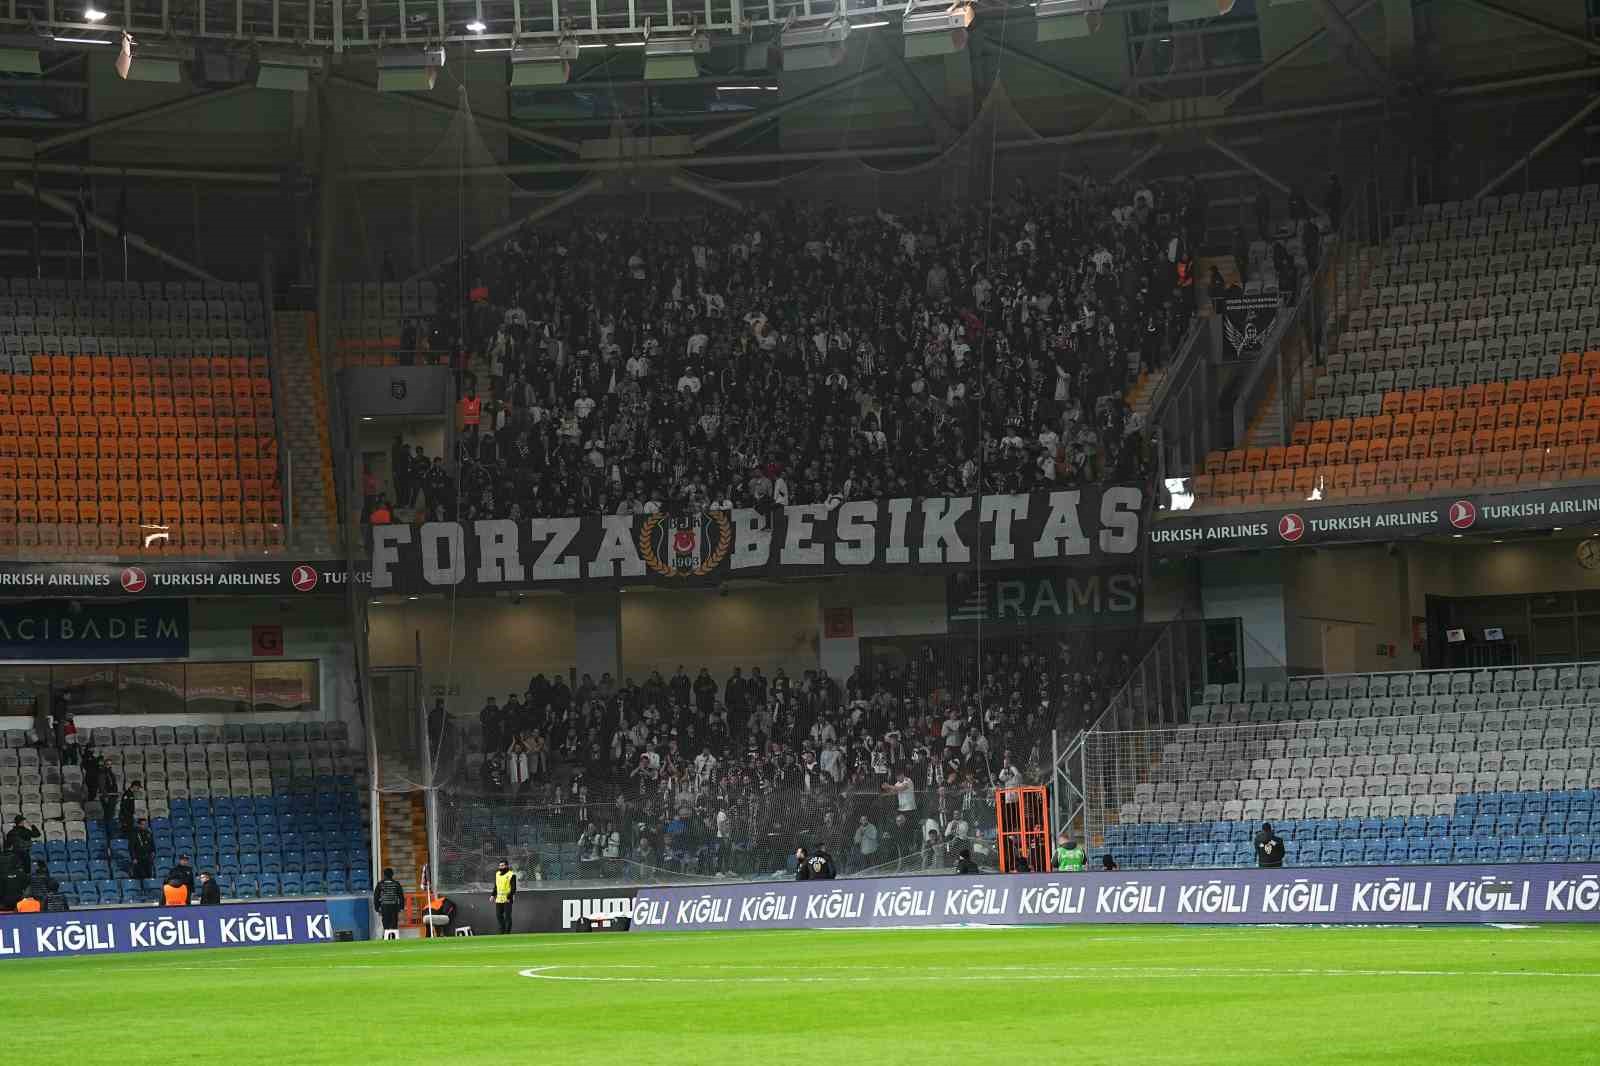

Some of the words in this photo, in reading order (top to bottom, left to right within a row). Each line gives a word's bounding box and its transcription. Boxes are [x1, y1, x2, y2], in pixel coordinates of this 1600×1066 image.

[1481, 502, 1545, 519] TURKISH
[1549, 498, 1600, 514] AIRLIN
[1310, 515, 1371, 532] TURKISH
[1375, 510, 1438, 527] AIRLINES
[371, 513, 647, 588] FORZA
[730, 486, 1143, 570] BESIKTAS
[1148, 528, 1203, 543] URKISH
[1206, 523, 1268, 539] AIRLINES
[0, 573, 44, 585] RKISH
[49, 573, 110, 586] AIRLINES
[153, 573, 214, 585] TURKISH
[218, 572, 281, 585] AIRLINES
[997, 574, 1138, 619] RAMS
[258, 631, 277, 649] G
